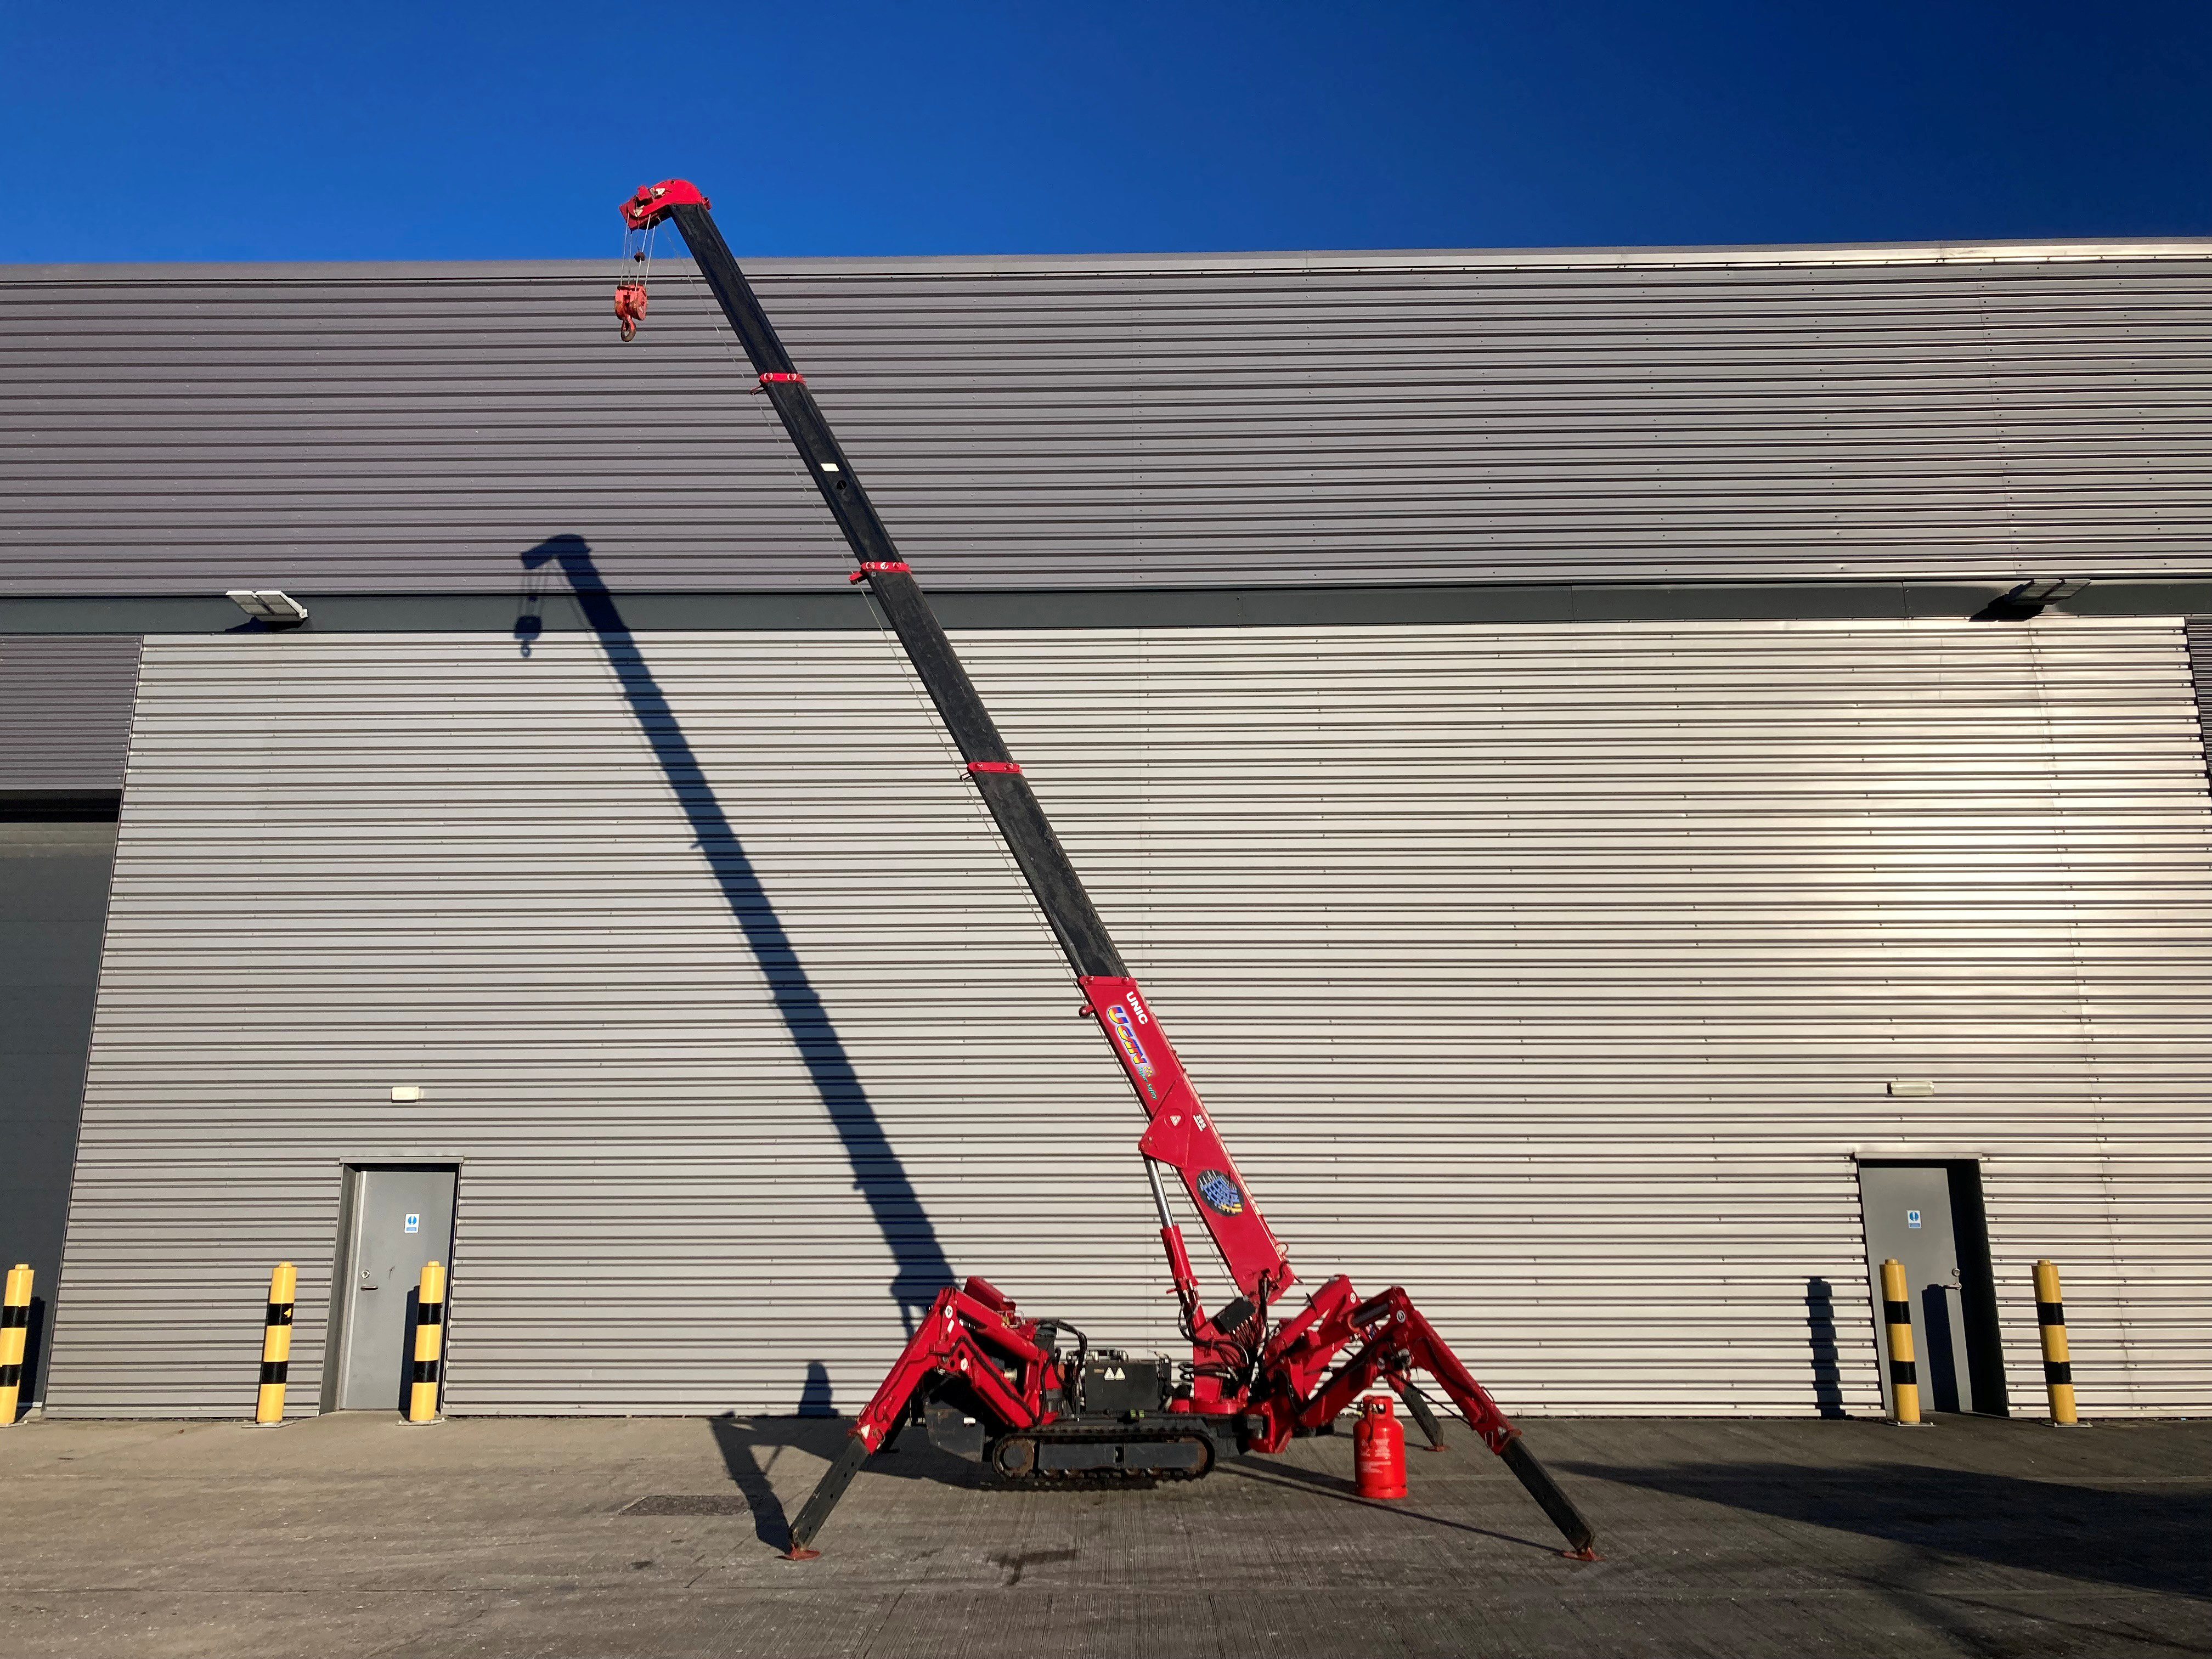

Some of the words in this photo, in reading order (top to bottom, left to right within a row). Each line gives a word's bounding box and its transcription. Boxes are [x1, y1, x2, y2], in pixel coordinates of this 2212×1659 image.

[1126, 991, 1148, 1024] UNIC
[1137, 1066, 1148, 1082] Super
[1146, 1083, 1158, 1100] Safety
